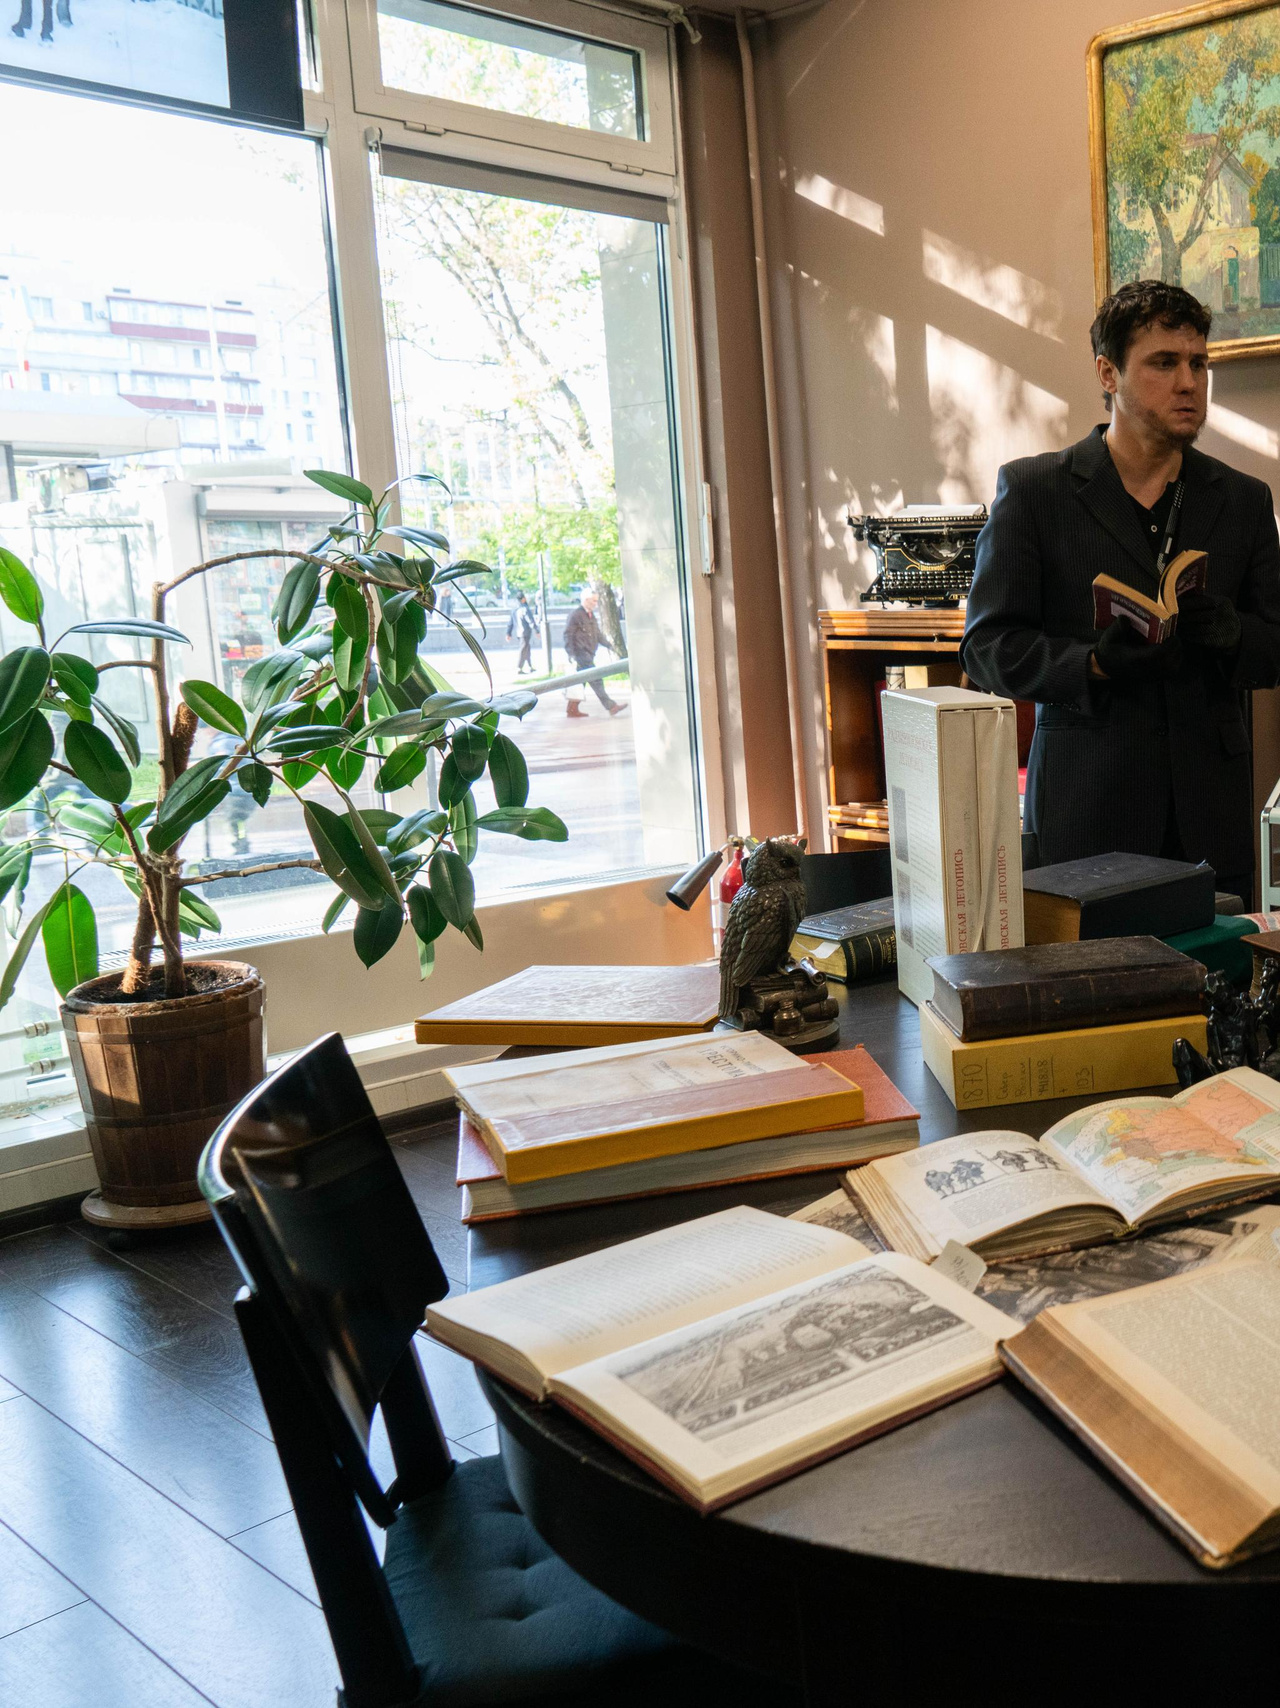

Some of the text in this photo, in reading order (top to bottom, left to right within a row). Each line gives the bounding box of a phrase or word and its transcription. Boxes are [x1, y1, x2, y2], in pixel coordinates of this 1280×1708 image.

[953, 848, 965, 908] ЛЕТОПИСЬ
[997, 845, 1008, 904] ЛЕТОПИСЬ
[961, 1063, 983, 1103] 1870
